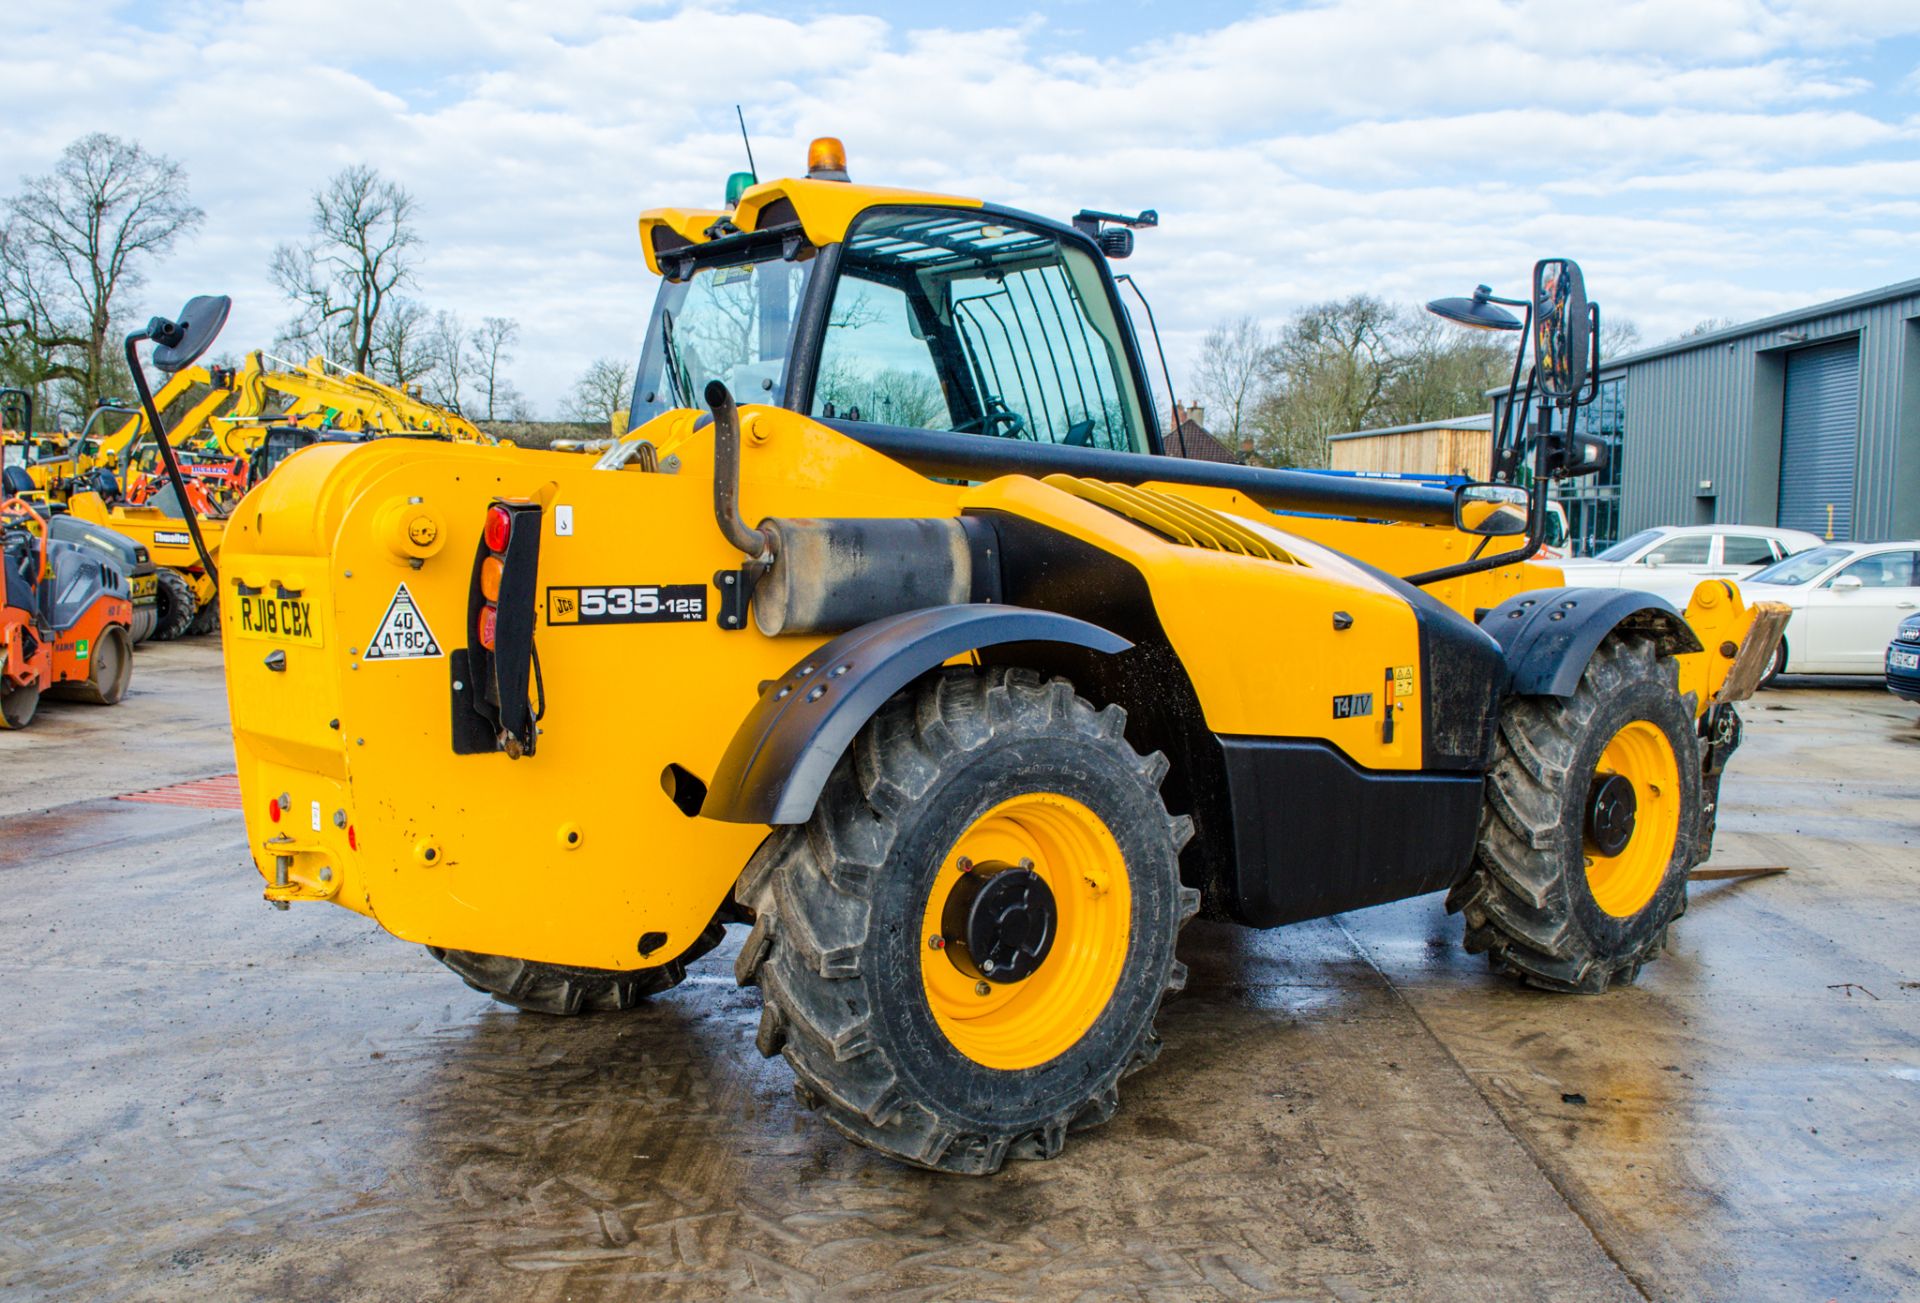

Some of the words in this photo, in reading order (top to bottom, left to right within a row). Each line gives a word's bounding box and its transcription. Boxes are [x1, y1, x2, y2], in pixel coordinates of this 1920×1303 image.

[557, 598, 574, 614] JCB
[242, 598, 277, 633] RJ18
[281, 602, 312, 638] CBX
[383, 631, 425, 650] AT8C
[1335, 697, 1349, 716] T4
